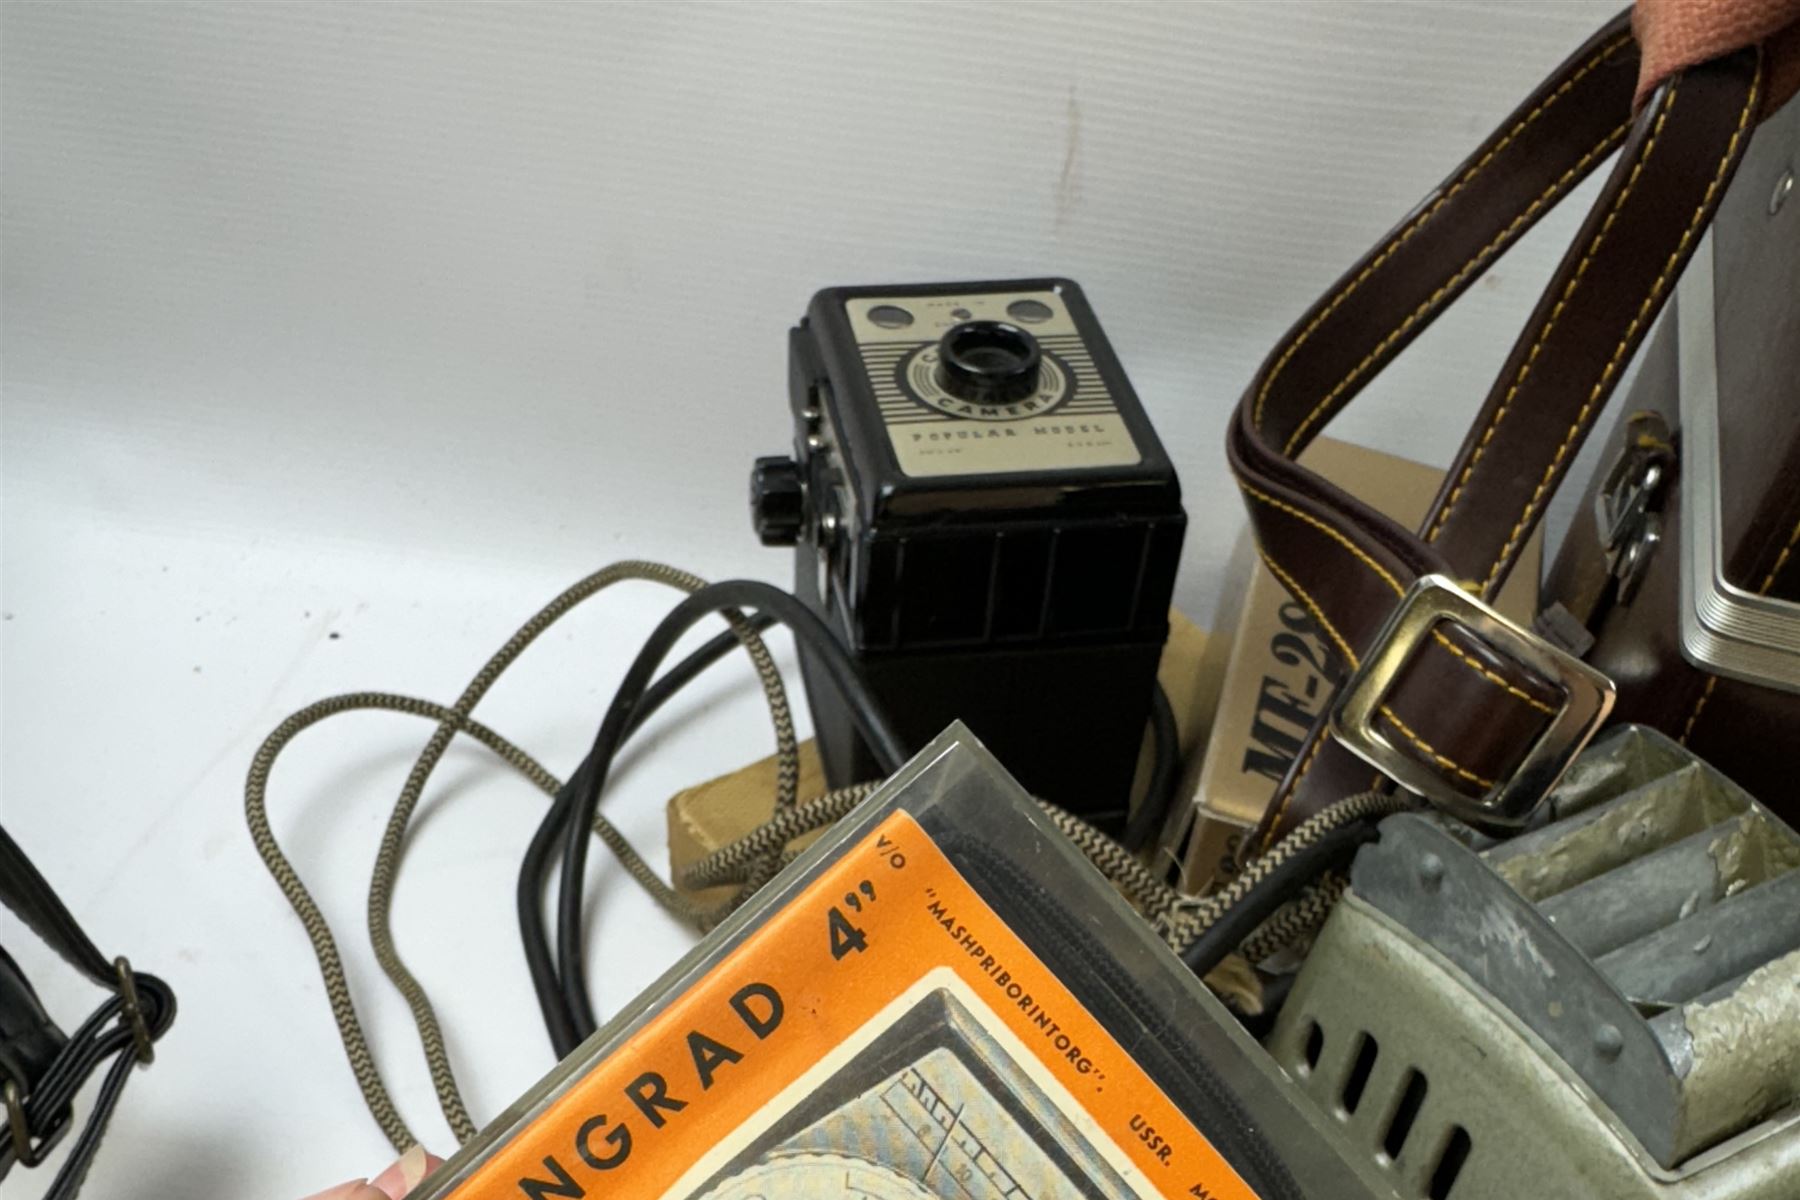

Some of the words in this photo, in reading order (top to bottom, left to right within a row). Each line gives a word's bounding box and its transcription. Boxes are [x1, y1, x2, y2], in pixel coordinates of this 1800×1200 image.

[937, 393, 1053, 416] CAMERA
[913, 428, 1017, 442] POPULAR
[1034, 424, 1106, 435] MODEL
[826, 879, 876, 960] 4”
[875, 834, 906, 871] V/O
[1128, 1114, 1172, 1167] USSR.
